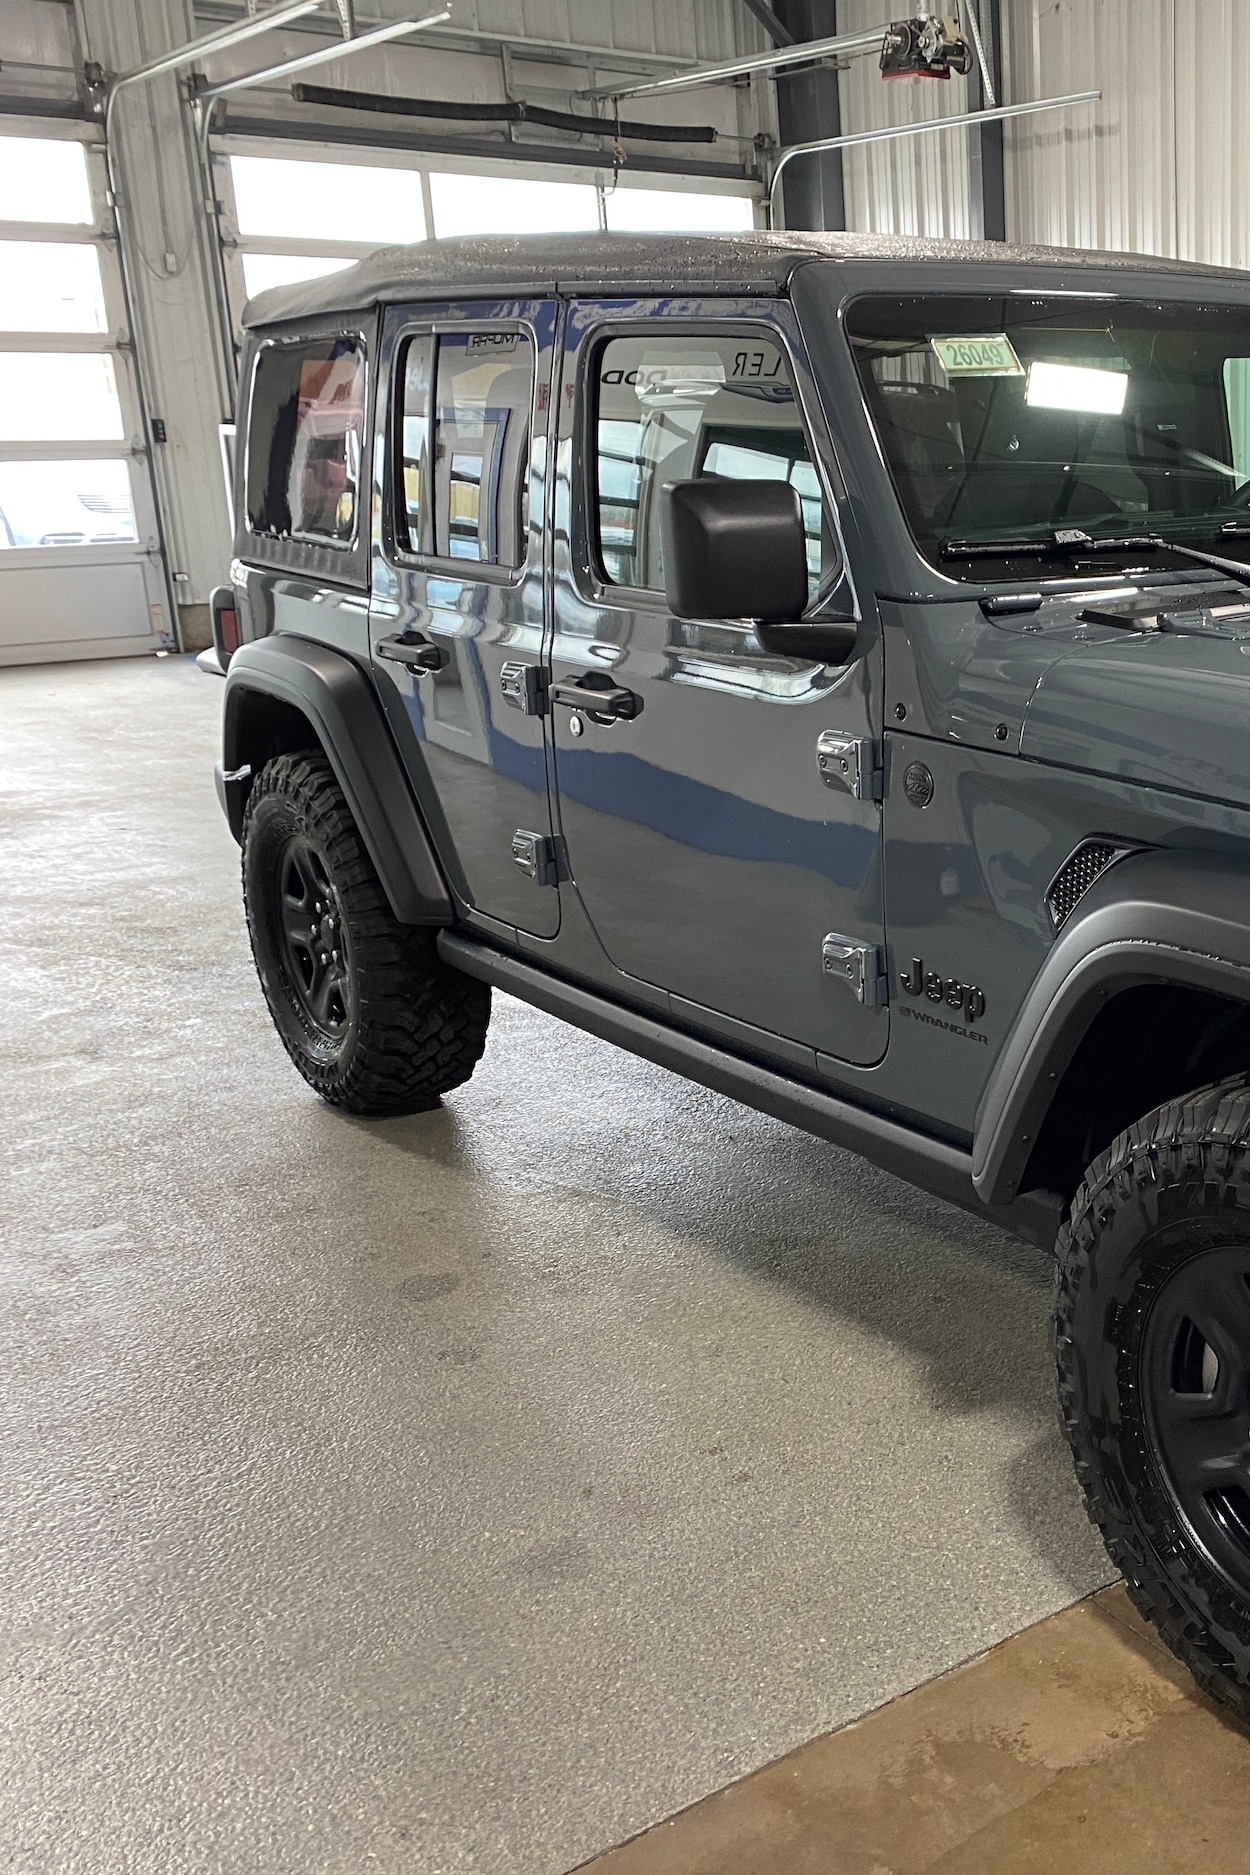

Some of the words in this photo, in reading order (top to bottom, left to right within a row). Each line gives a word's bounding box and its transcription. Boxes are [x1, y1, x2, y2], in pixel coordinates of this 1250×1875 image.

[945, 344, 1004, 366] 26049
[899, 957, 985, 1023] Jeep
[911, 1009, 989, 1046] WRANGLER
